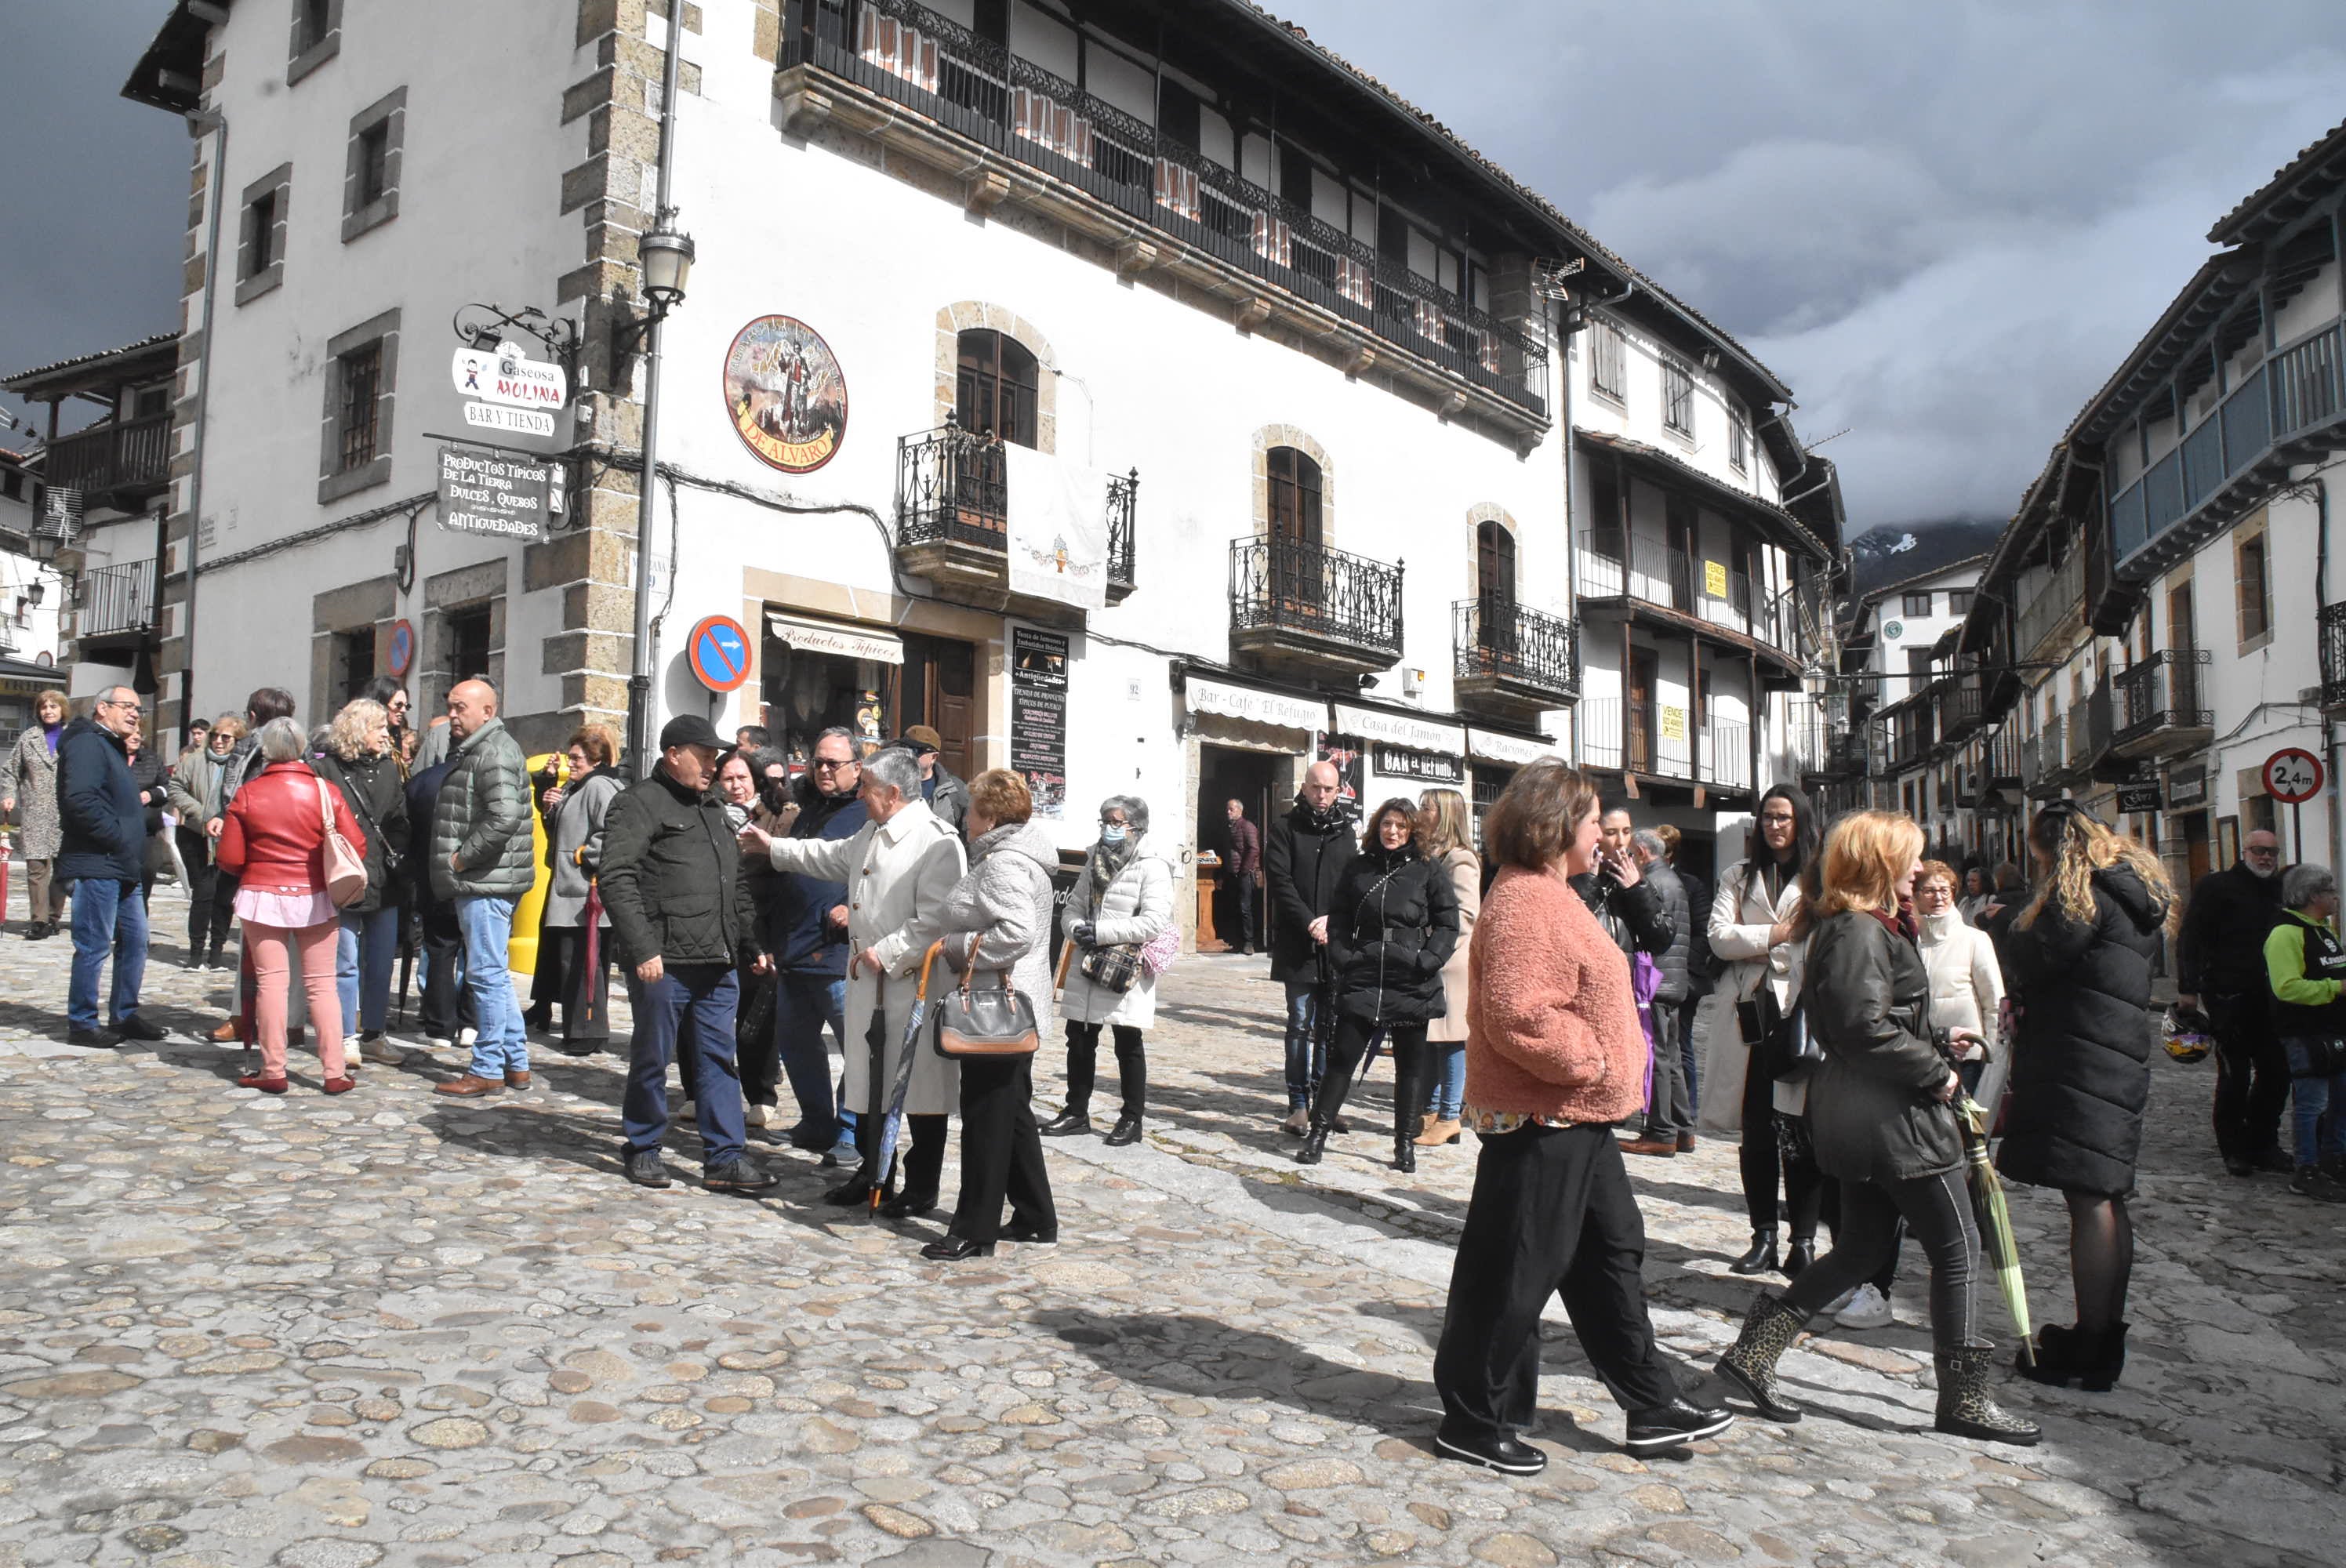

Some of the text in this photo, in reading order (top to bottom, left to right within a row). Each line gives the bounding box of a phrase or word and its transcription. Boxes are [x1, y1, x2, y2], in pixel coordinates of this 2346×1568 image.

[502, 361, 554, 382] Gaseosa
[497, 379, 560, 405] MOLINA
[469, 406, 550, 432] BAR Y TIENDA
[744, 421, 768, 450] DE
[768, 440, 828, 464] ALVARO
[781, 627, 844, 650] Productos
[1198, 688, 1220, 704] Bar
[1362, 715, 1387, 733] Casa
[1391, 720, 1409, 736] del
[1384, 749, 1409, 773] BAR
[1411, 756, 1420, 768] EL
